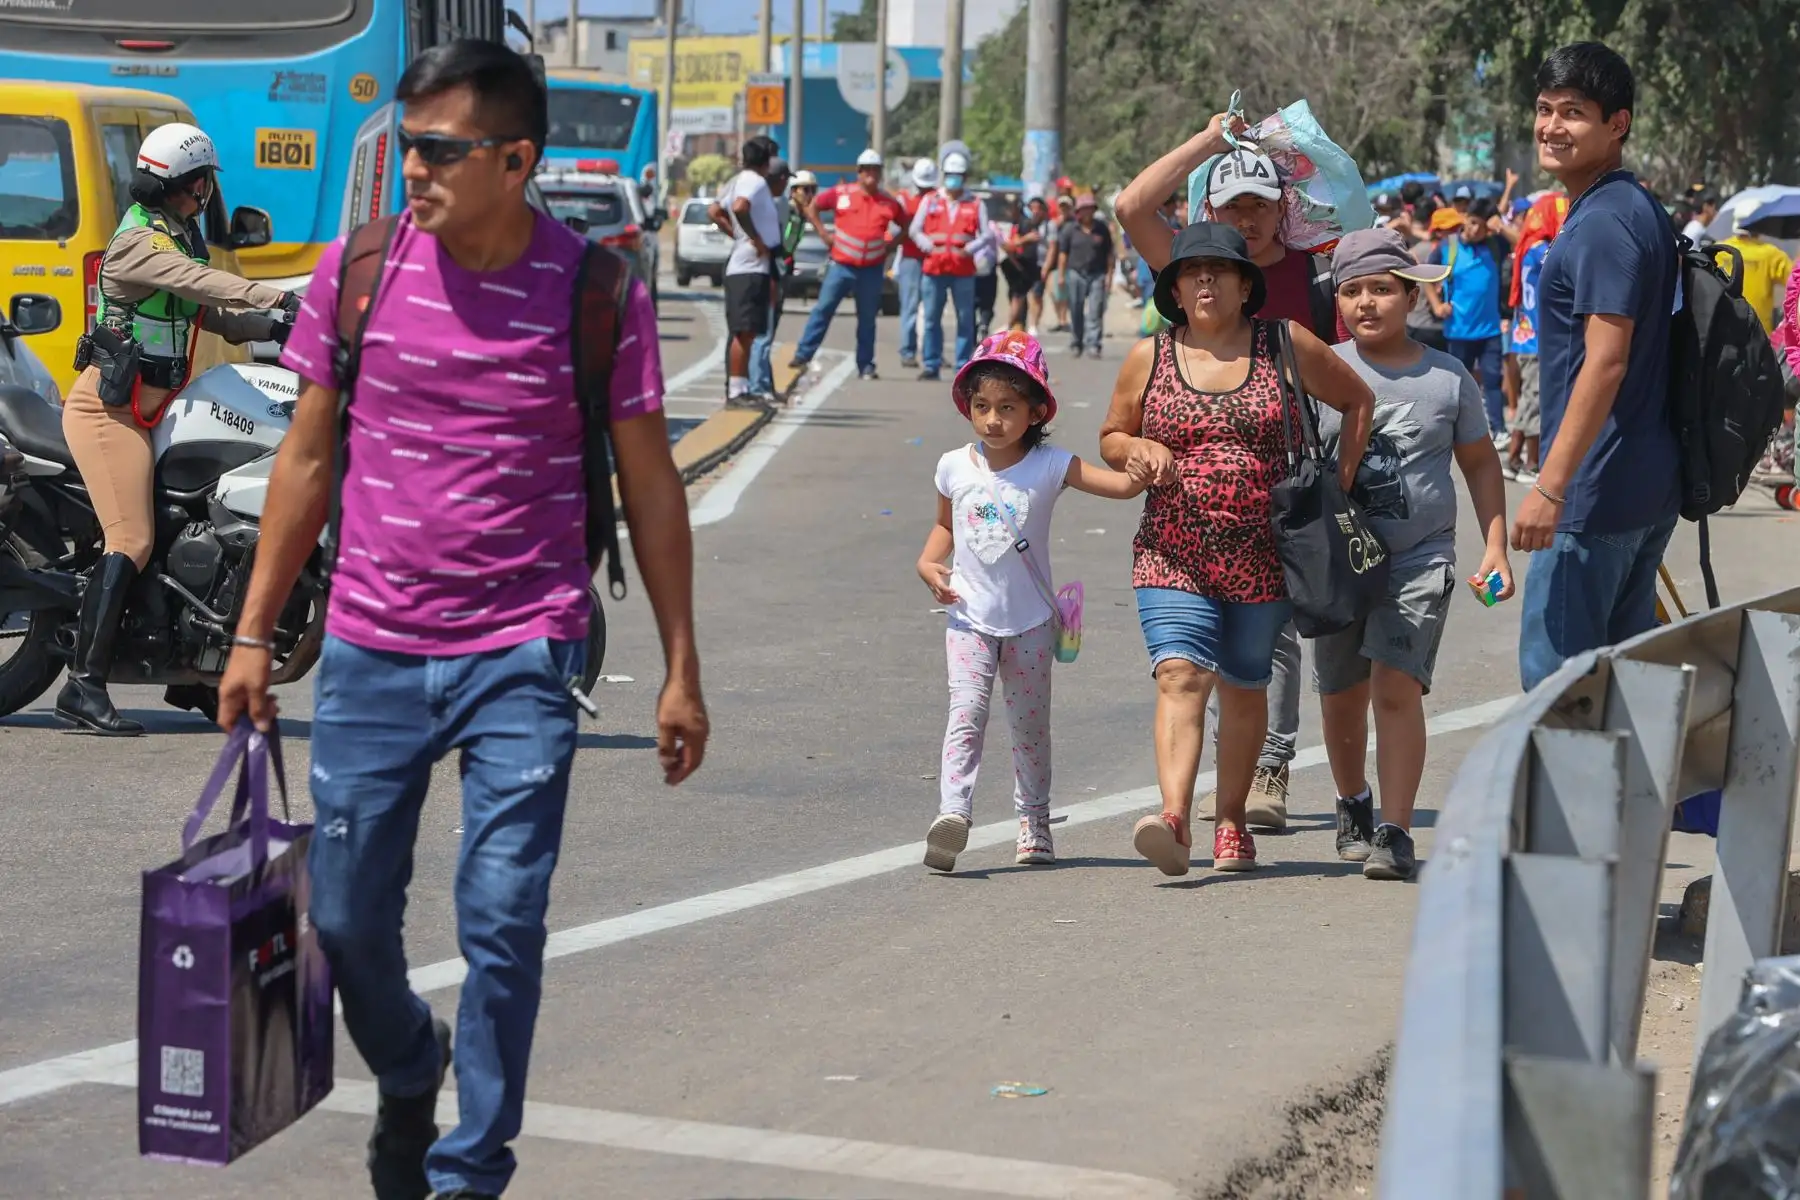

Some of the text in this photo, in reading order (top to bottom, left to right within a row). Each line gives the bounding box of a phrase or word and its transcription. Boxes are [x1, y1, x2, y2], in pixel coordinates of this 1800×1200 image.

[353, 78, 375, 97] 50
[260, 142, 311, 165] 1801
[1219, 160, 1270, 184] FILA
[210, 401, 254, 435] PL.18409
